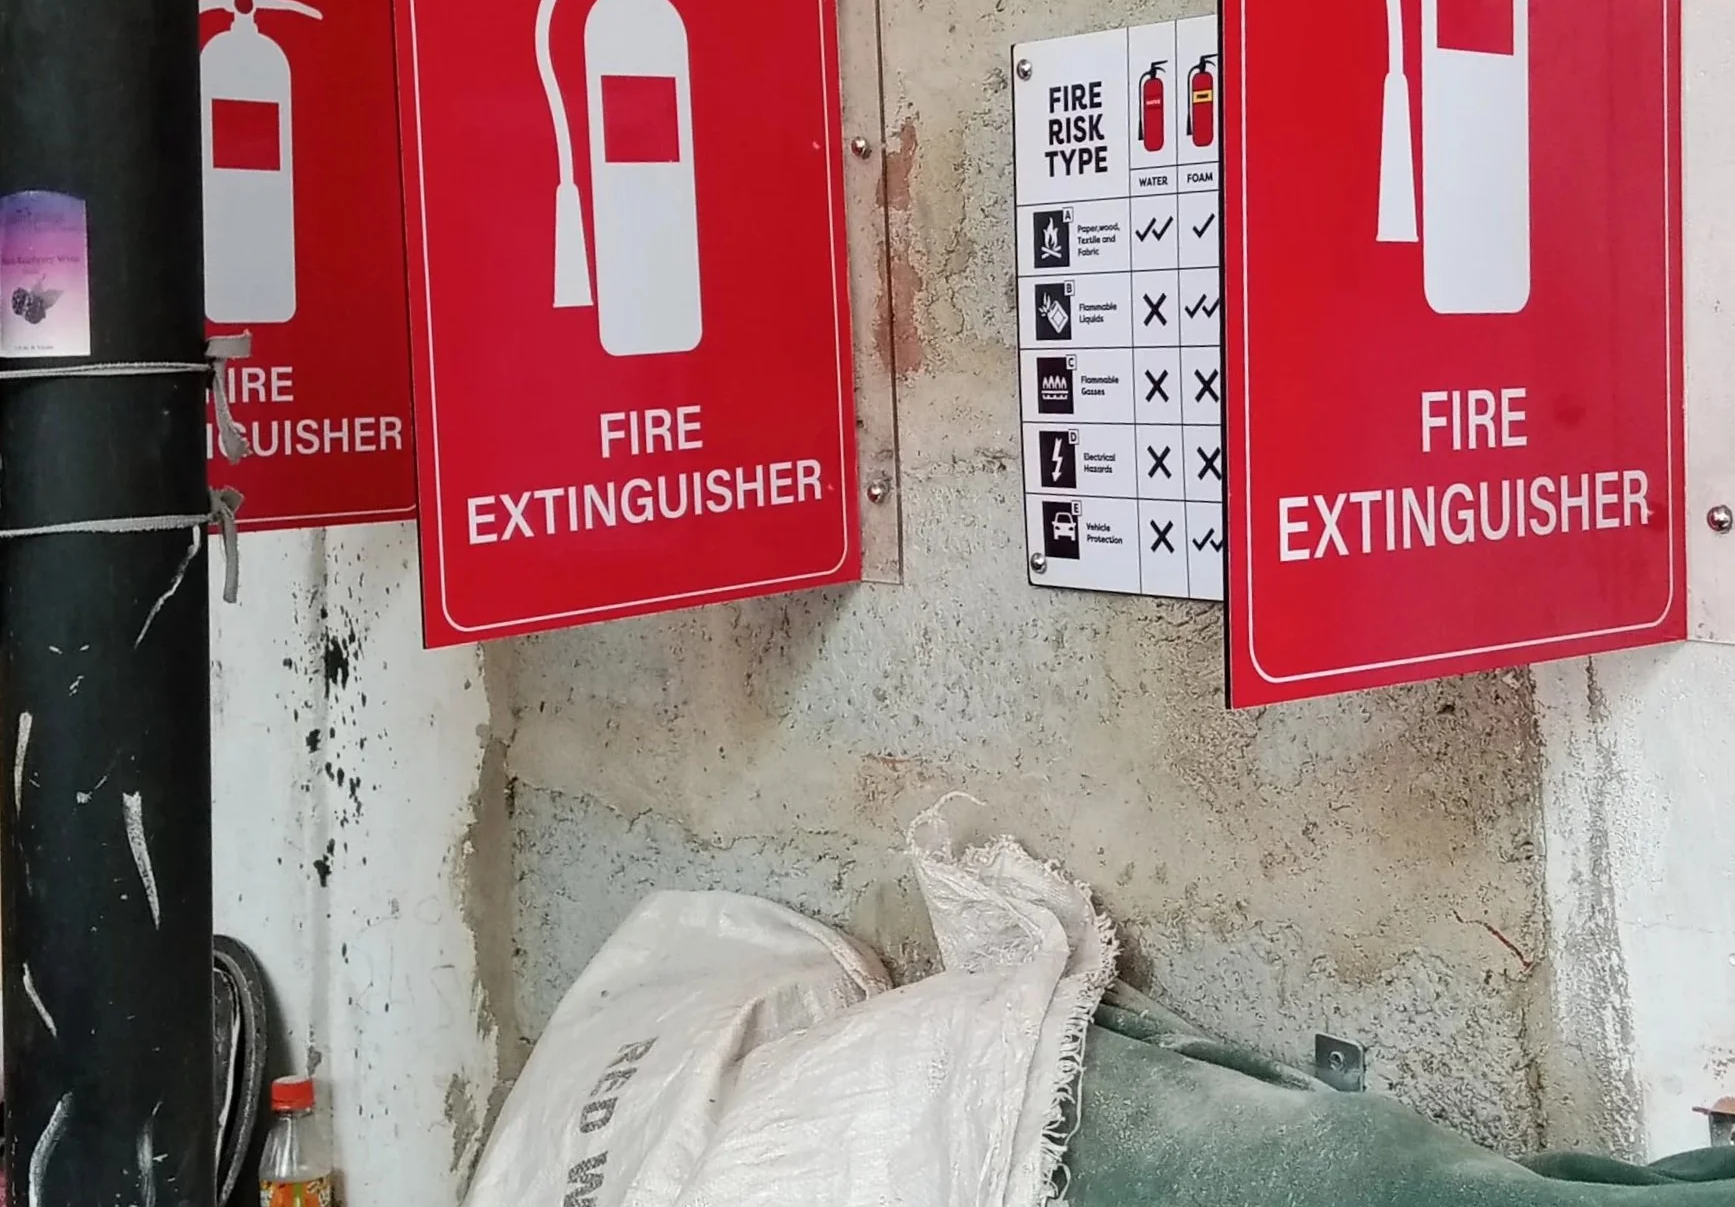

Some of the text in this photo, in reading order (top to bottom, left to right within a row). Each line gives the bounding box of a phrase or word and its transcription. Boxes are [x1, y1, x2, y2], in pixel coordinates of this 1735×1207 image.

[1049, 81, 1102, 113] FIRE
[1048, 114, 1105, 145] RISK
[1045, 146, 1108, 177] TYPE
[1139, 176, 1168, 187] WATER
[1187, 172, 1213, 184] FOAM
[1064, 210, 1072, 221] A
[1077, 235, 1116, 245] Textile and
[1077, 248, 1100, 257] Fabric
[1066, 283, 1073, 294] B
[1079, 302, 1118, 311] Flammable
[1079, 314, 1104, 324] Liquids
[1067, 357, 1075, 368] C
[1080, 375, 1119, 385] Flammable
[1421, 387, 1528, 453] FIRE
[600, 404, 703, 459] FIRE
[1070, 431, 1078, 443] D
[1083, 452, 1117, 462] Electrical
[1083, 464, 1113, 474] Hazards
[466, 458, 823, 545] EXTINGUISHER
[1073, 502, 1080, 514] E
[1278, 469, 1650, 562] EXTINGUISHER
[1086, 522, 1111, 533] Vehicle
[1086, 534, 1123, 545] Protection
[579, 1034, 660, 1133] RED
